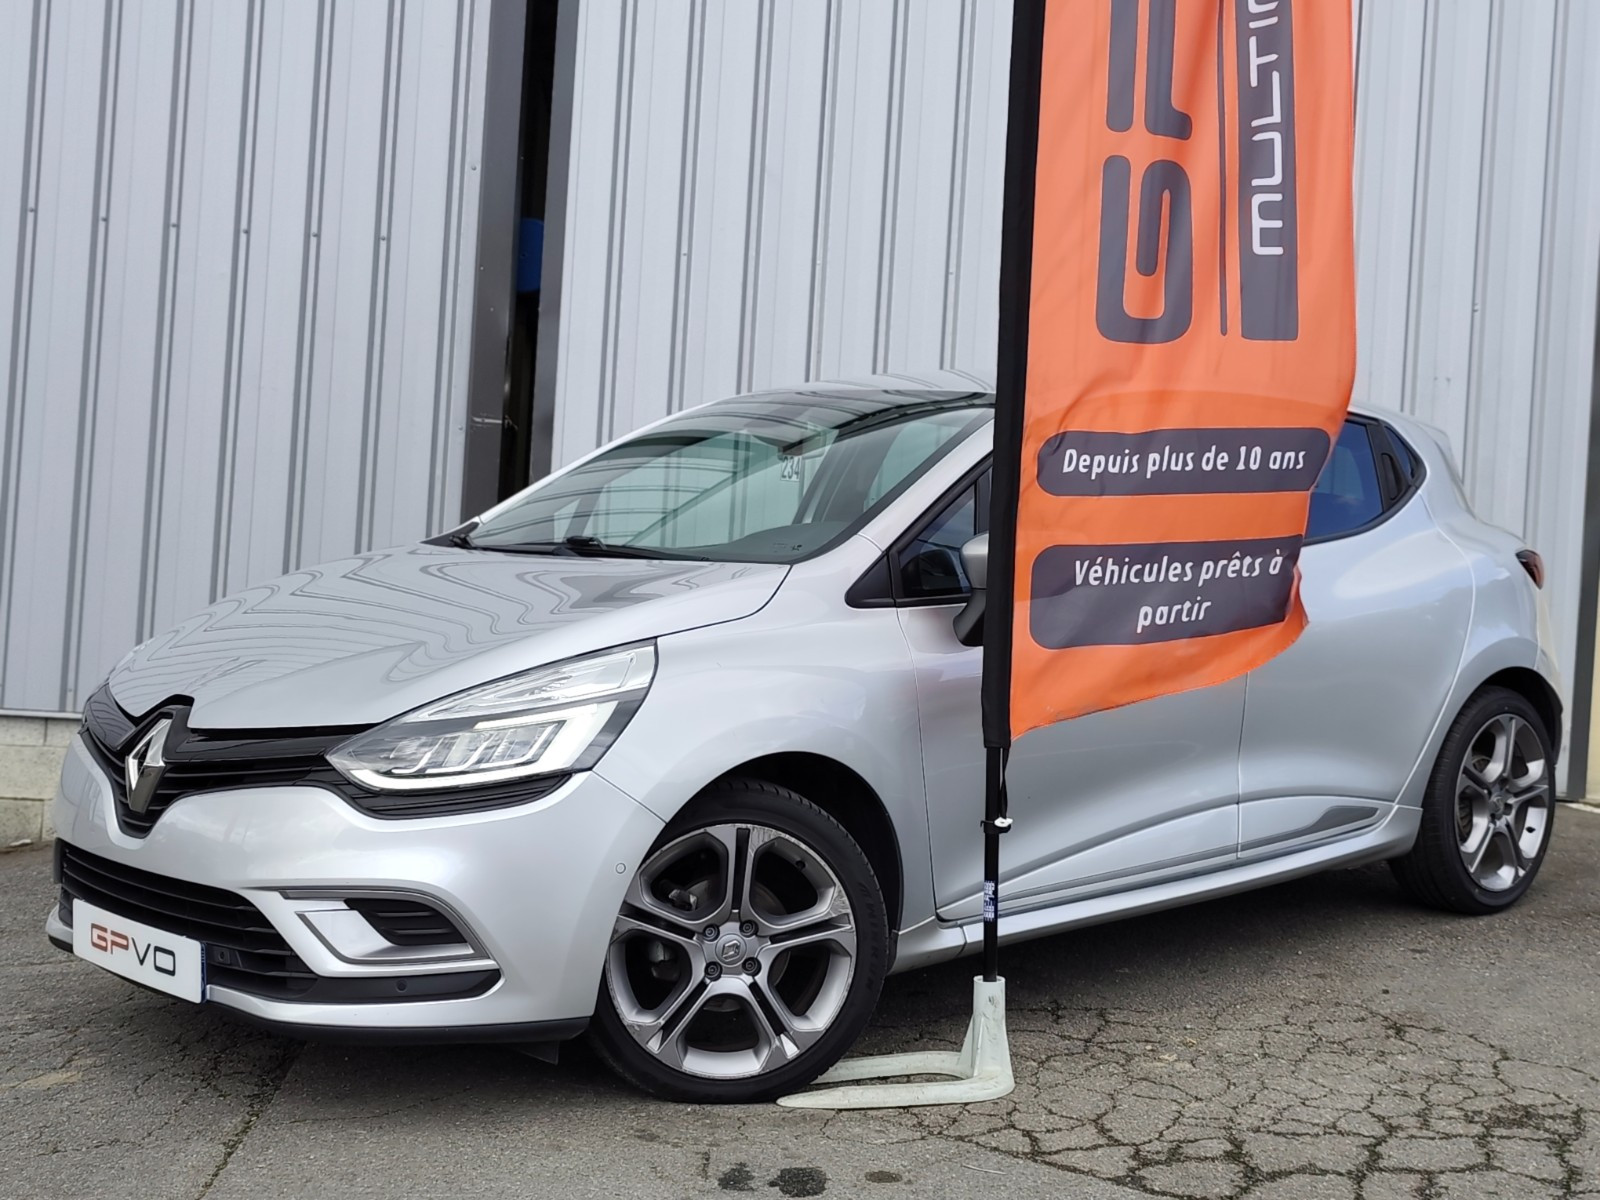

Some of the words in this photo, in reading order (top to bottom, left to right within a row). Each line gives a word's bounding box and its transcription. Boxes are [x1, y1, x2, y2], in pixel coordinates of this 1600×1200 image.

[1247, 0, 1284, 256] MULTI
[781, 456, 800, 480] 234
[1062, 448, 1140, 480] Depuis
[1146, 445, 1195, 479] plus
[1201, 445, 1230, 471] de
[1235, 446, 1261, 471] 10
[1269, 449, 1306, 471] ans
[1074, 556, 1193, 587] Véhicules
[1198, 551, 1261, 588] prêts
[1268, 549, 1284, 576] à
[1136, 596, 1212, 634] partir
